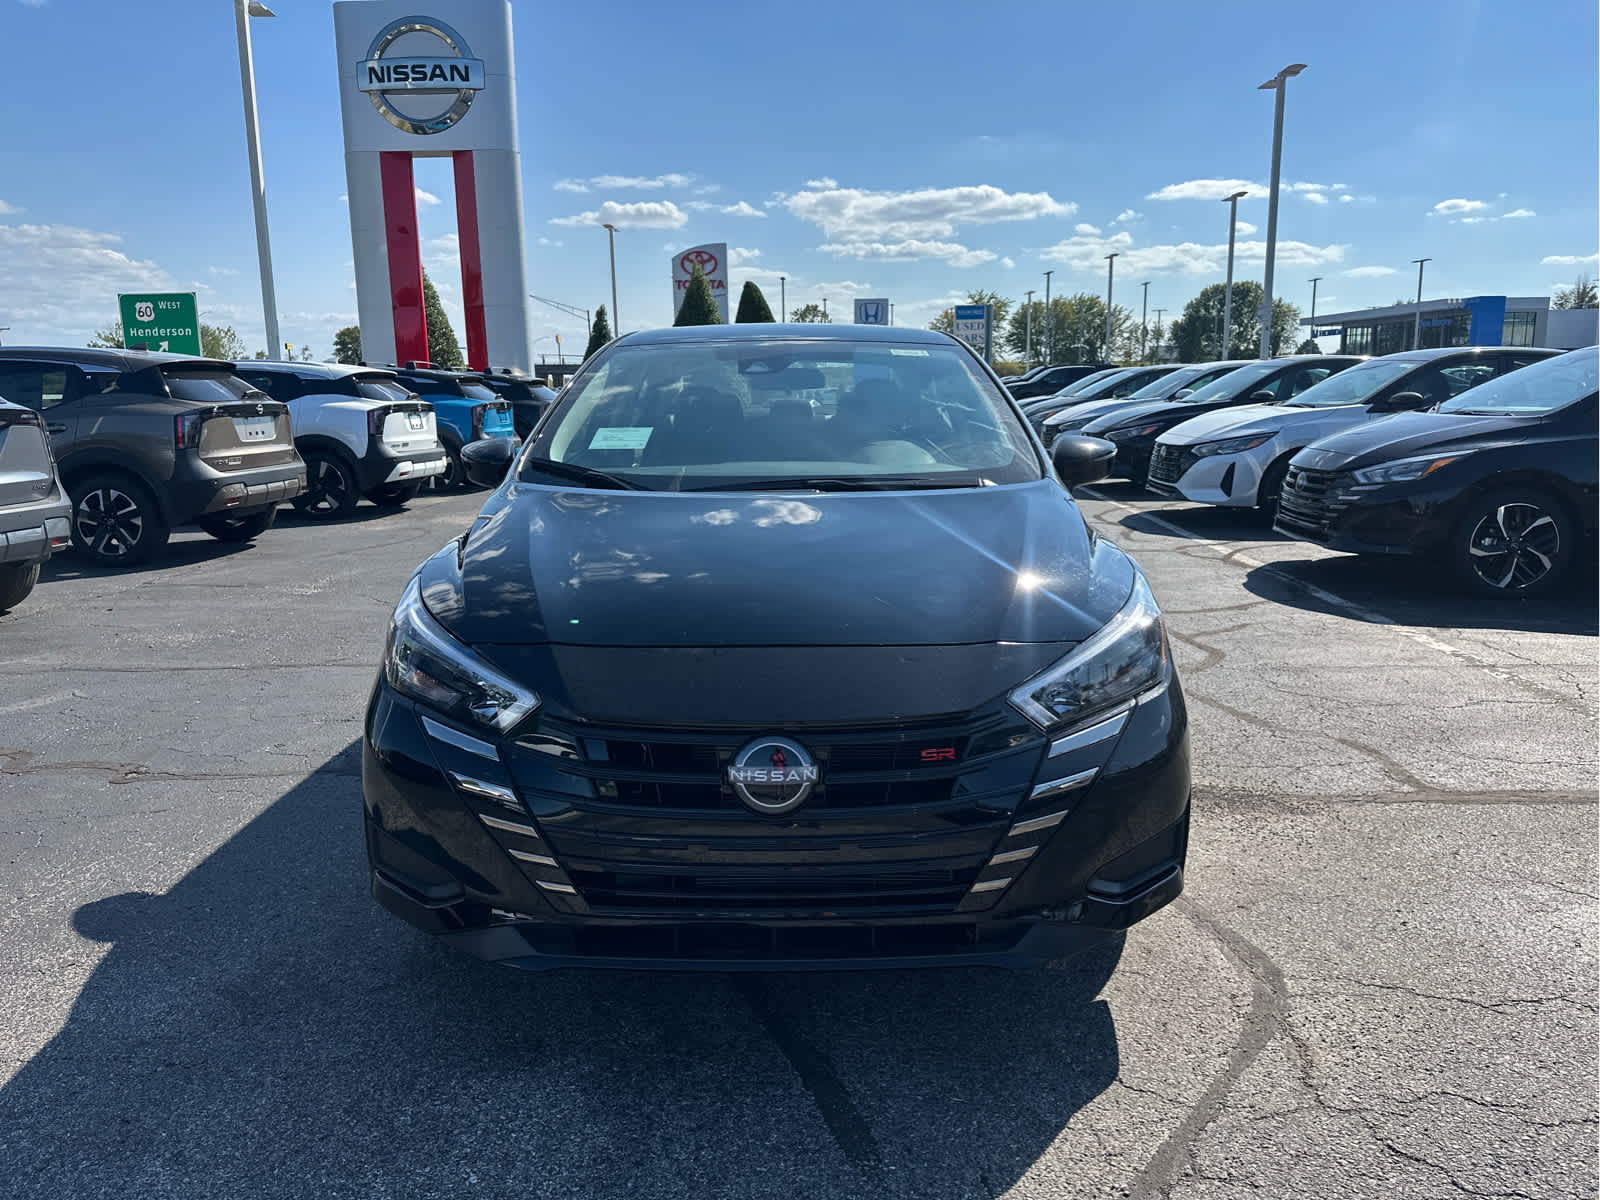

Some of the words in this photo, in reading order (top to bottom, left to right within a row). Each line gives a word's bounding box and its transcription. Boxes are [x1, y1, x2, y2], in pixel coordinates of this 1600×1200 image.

[368, 63, 470, 84] NISSAN
[675, 279, 725, 290] TOTA
[158, 301, 181, 309] WEST
[137, 305, 153, 318] 60
[129, 327, 192, 337] Henderson
[956, 321, 985, 331] USED
[920, 748, 955, 761] SR
[729, 768, 817, 782] NISSAN
